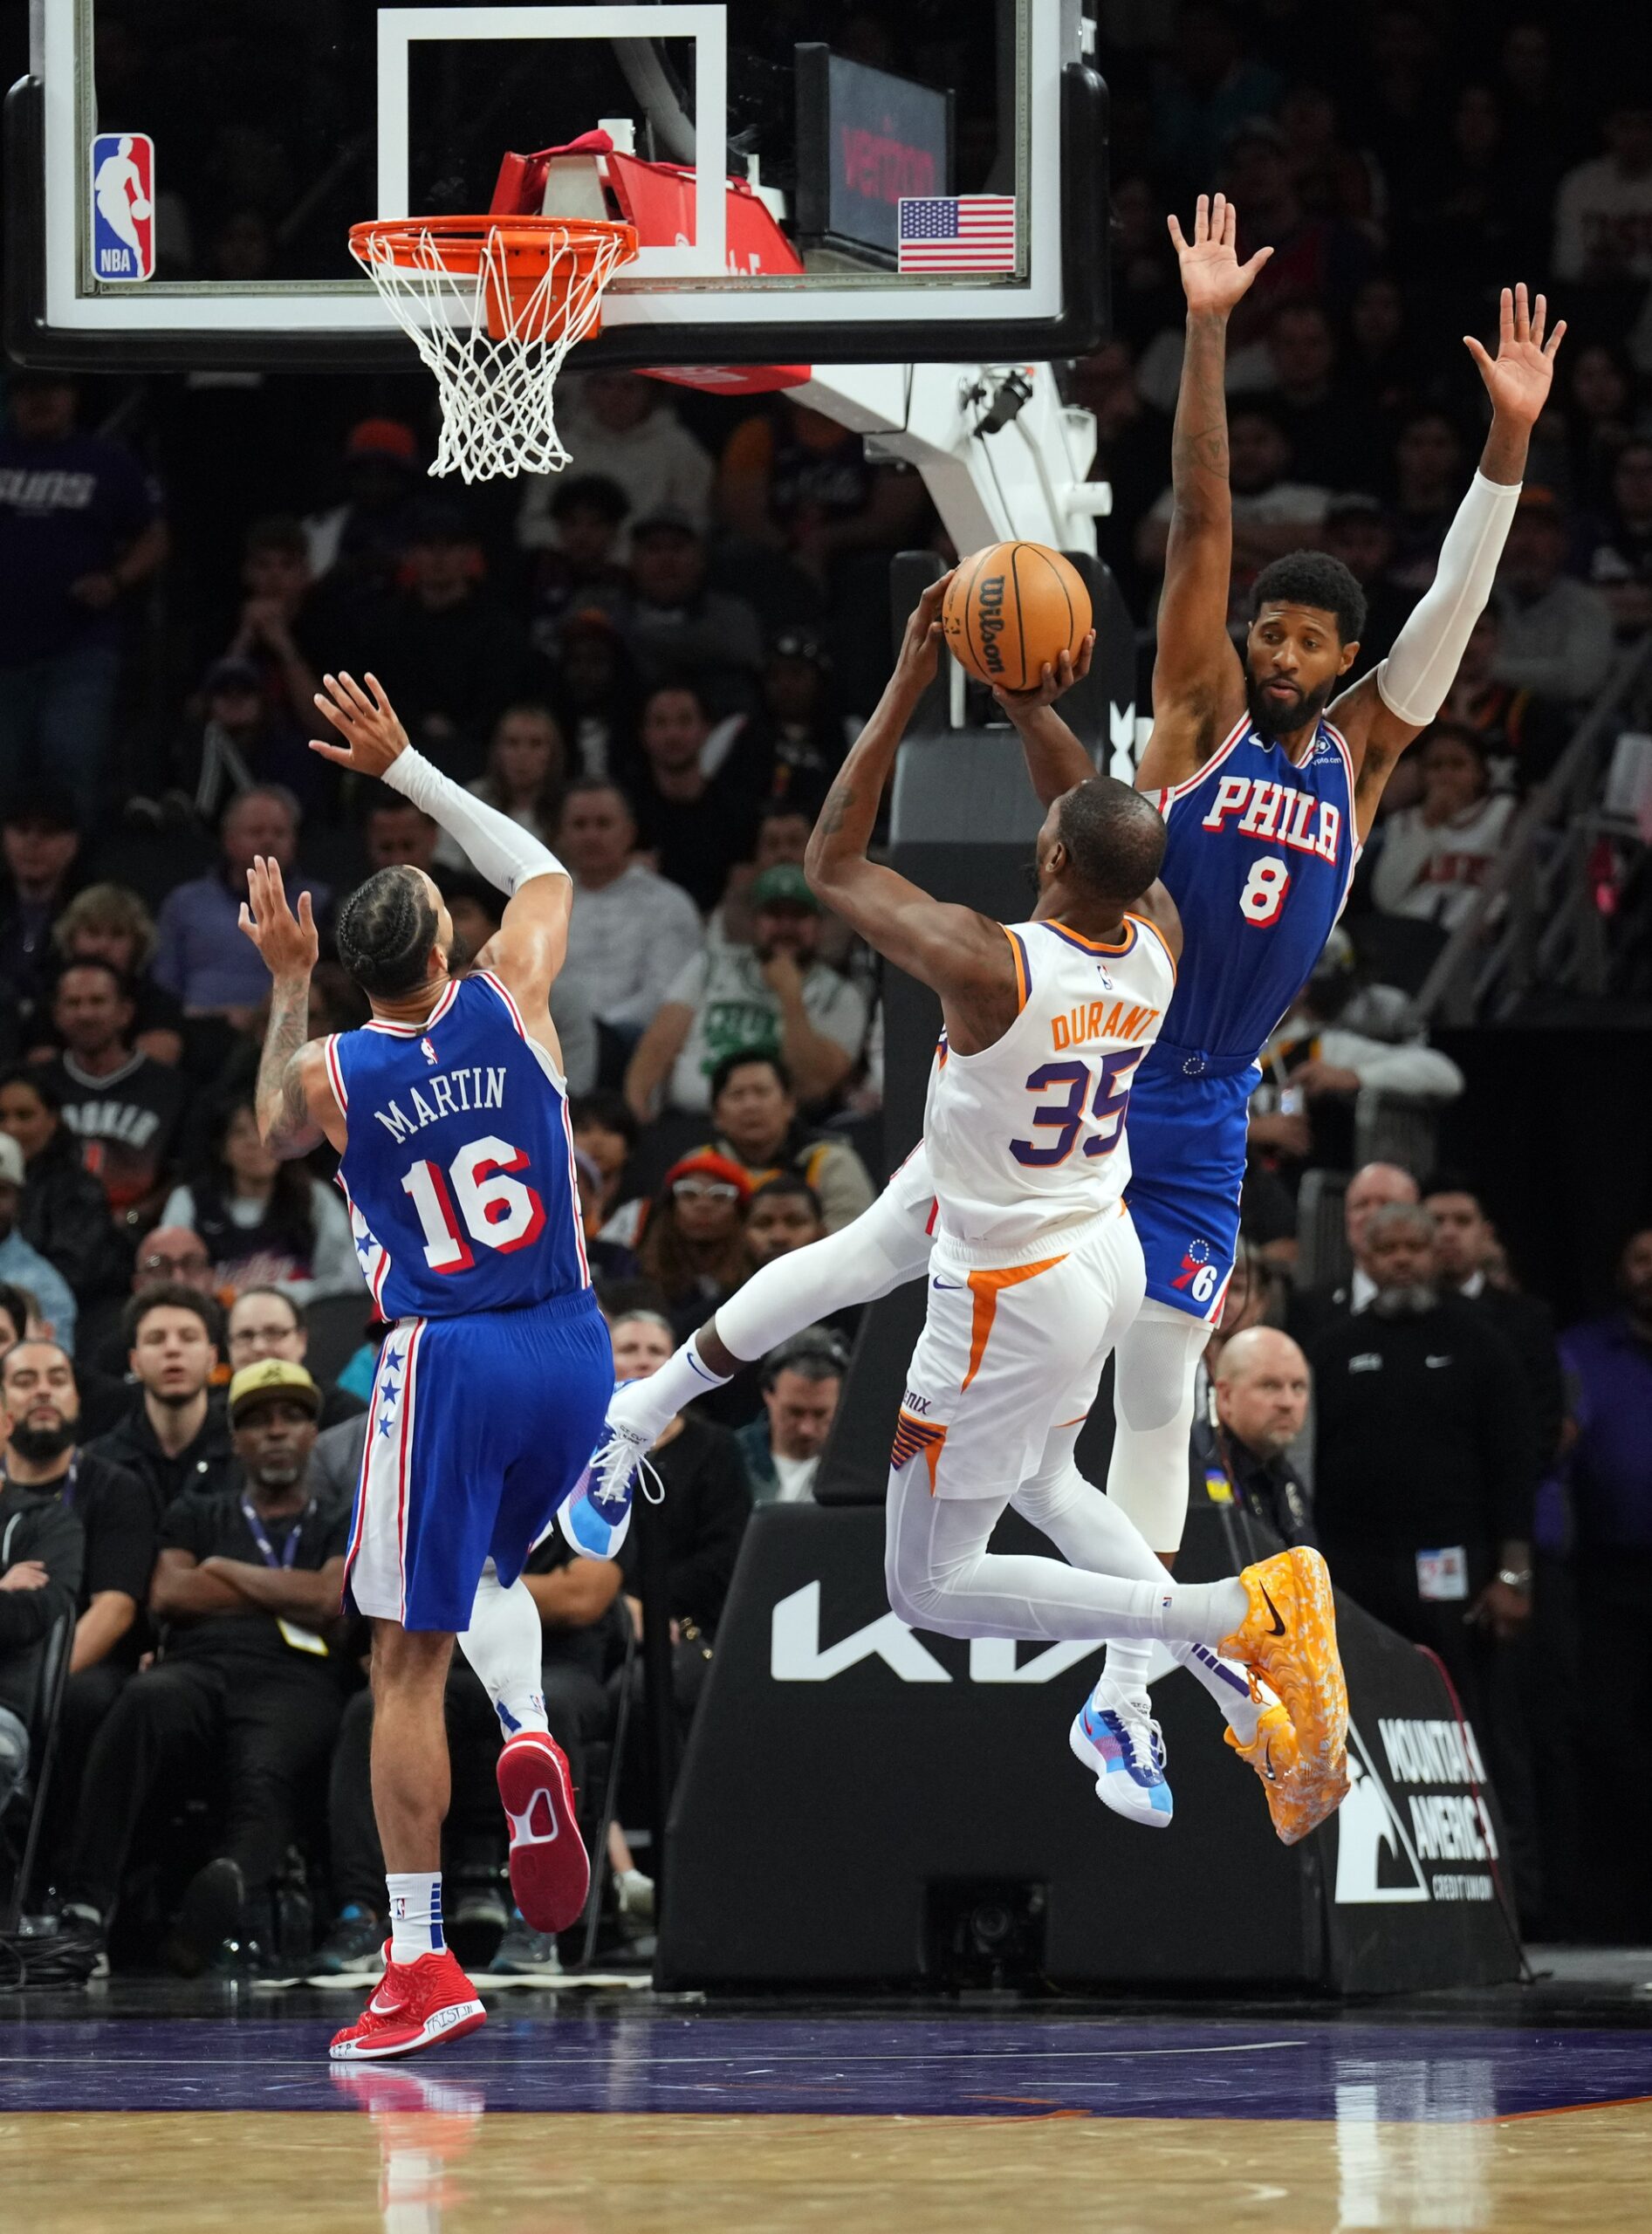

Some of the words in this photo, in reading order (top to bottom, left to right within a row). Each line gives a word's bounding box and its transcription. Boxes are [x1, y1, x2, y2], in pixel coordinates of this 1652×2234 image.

[100, 249, 131, 272] NBA
[978, 575, 1006, 674] Wilson
[1202, 776, 1341, 867] PHILA
[1239, 855, 1291, 929] 8
[1051, 1001, 1160, 1052] DURANT
[374, 1067, 506, 1144] MARTIN
[1009, 1046, 1144, 1168] 35
[401, 1135, 547, 1275] 16
[1378, 1717, 1487, 1784] MOUNTAIN
[1408, 1794, 1499, 1861] AMERICA
